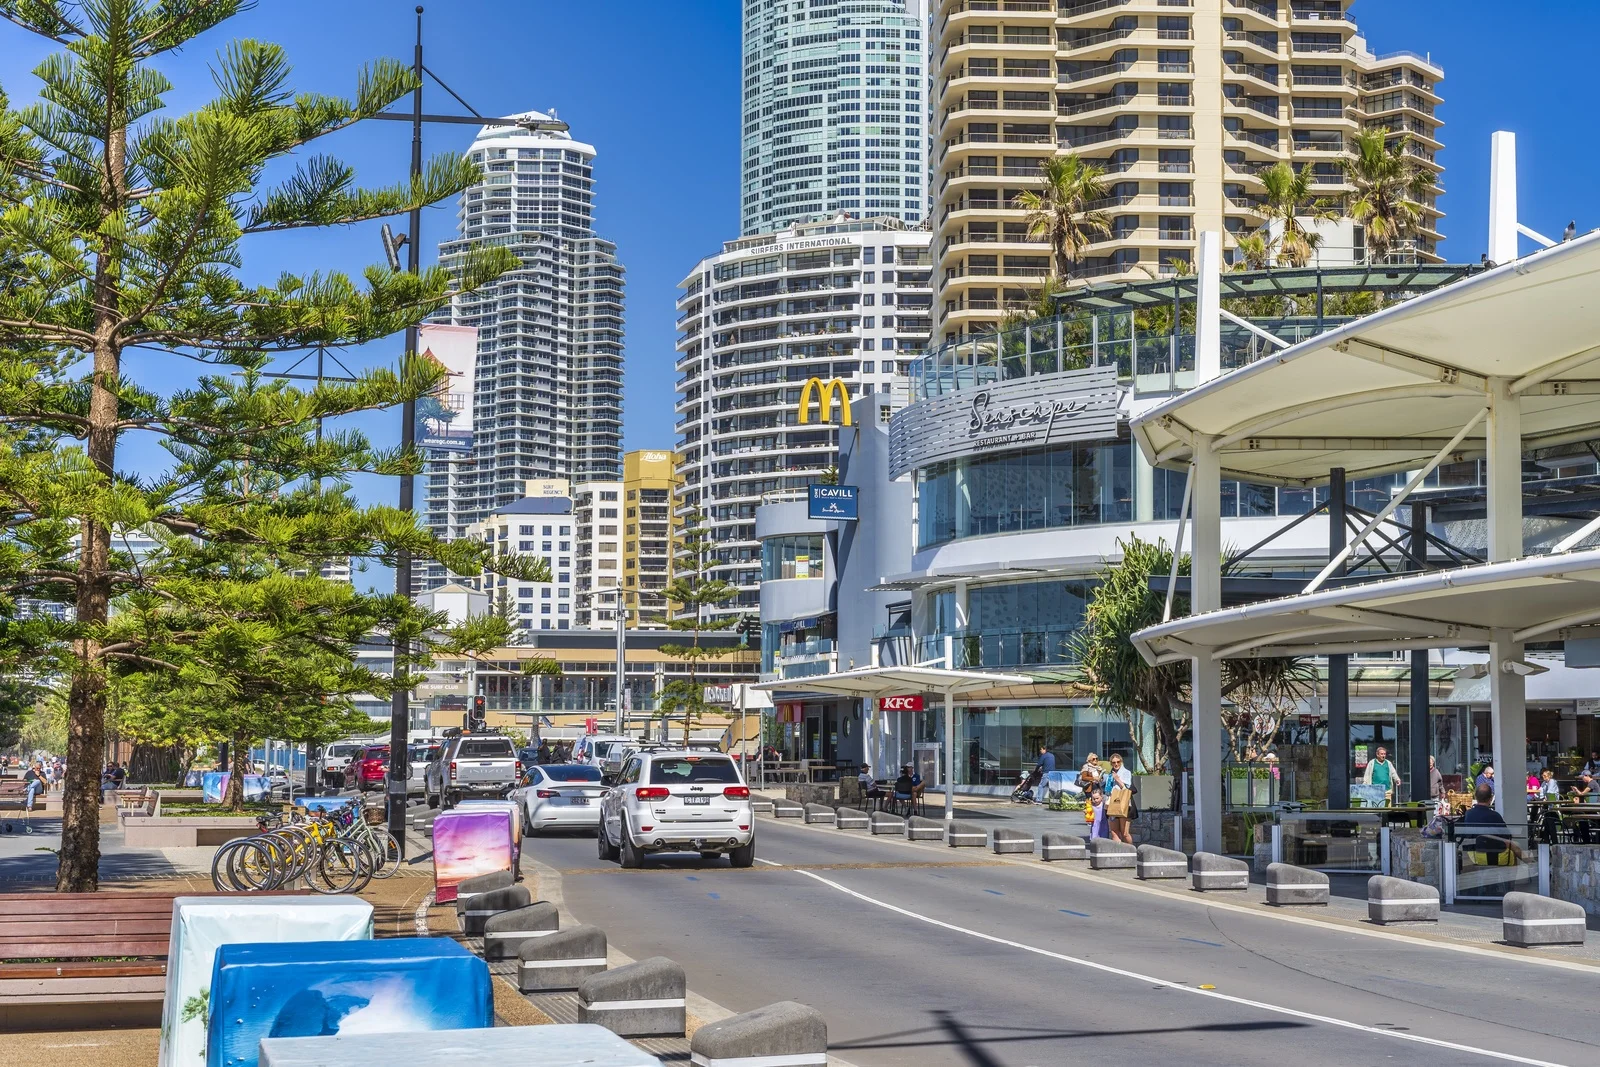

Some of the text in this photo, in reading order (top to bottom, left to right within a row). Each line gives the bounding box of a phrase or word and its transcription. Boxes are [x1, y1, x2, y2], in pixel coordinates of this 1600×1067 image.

[750, 237, 852, 255] SURFERS INTERNATIONAL
[969, 392, 1088, 443] Seascape
[423, 438, 466, 446] wearegc.com.au
[972, 435, 1011, 447] RESTAURANT
[1022, 432, 1036, 440] BAR
[640, 452, 667, 461] Aloha
[821, 488, 853, 498] CAVILL
[883, 697, 914, 709] KFC
